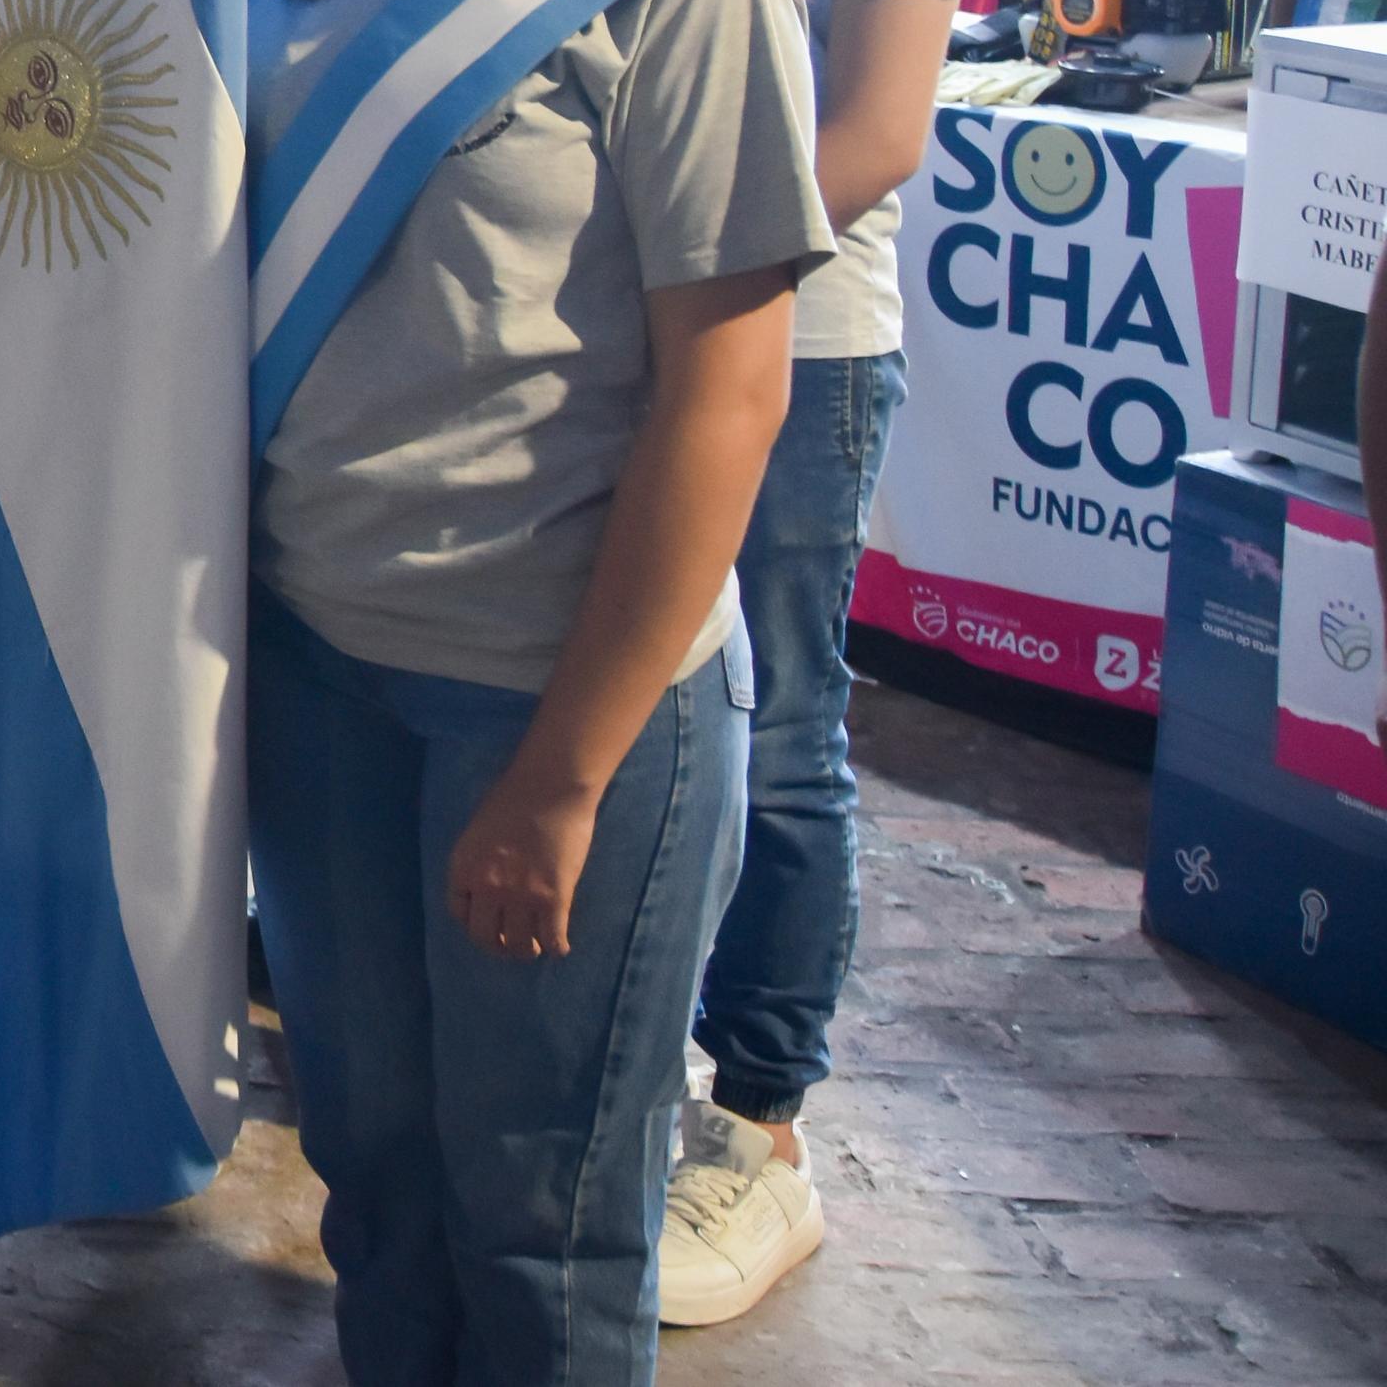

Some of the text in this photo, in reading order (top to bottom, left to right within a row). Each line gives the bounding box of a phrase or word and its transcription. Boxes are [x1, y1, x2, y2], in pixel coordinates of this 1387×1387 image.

[933, 107, 1190, 240] SOY
[1313, 171, 1387, 207] CAÑET
[927, 222, 1189, 367] CHA
[1006, 360, 1187, 489] CO
[956, 620, 1060, 663] CHACO
